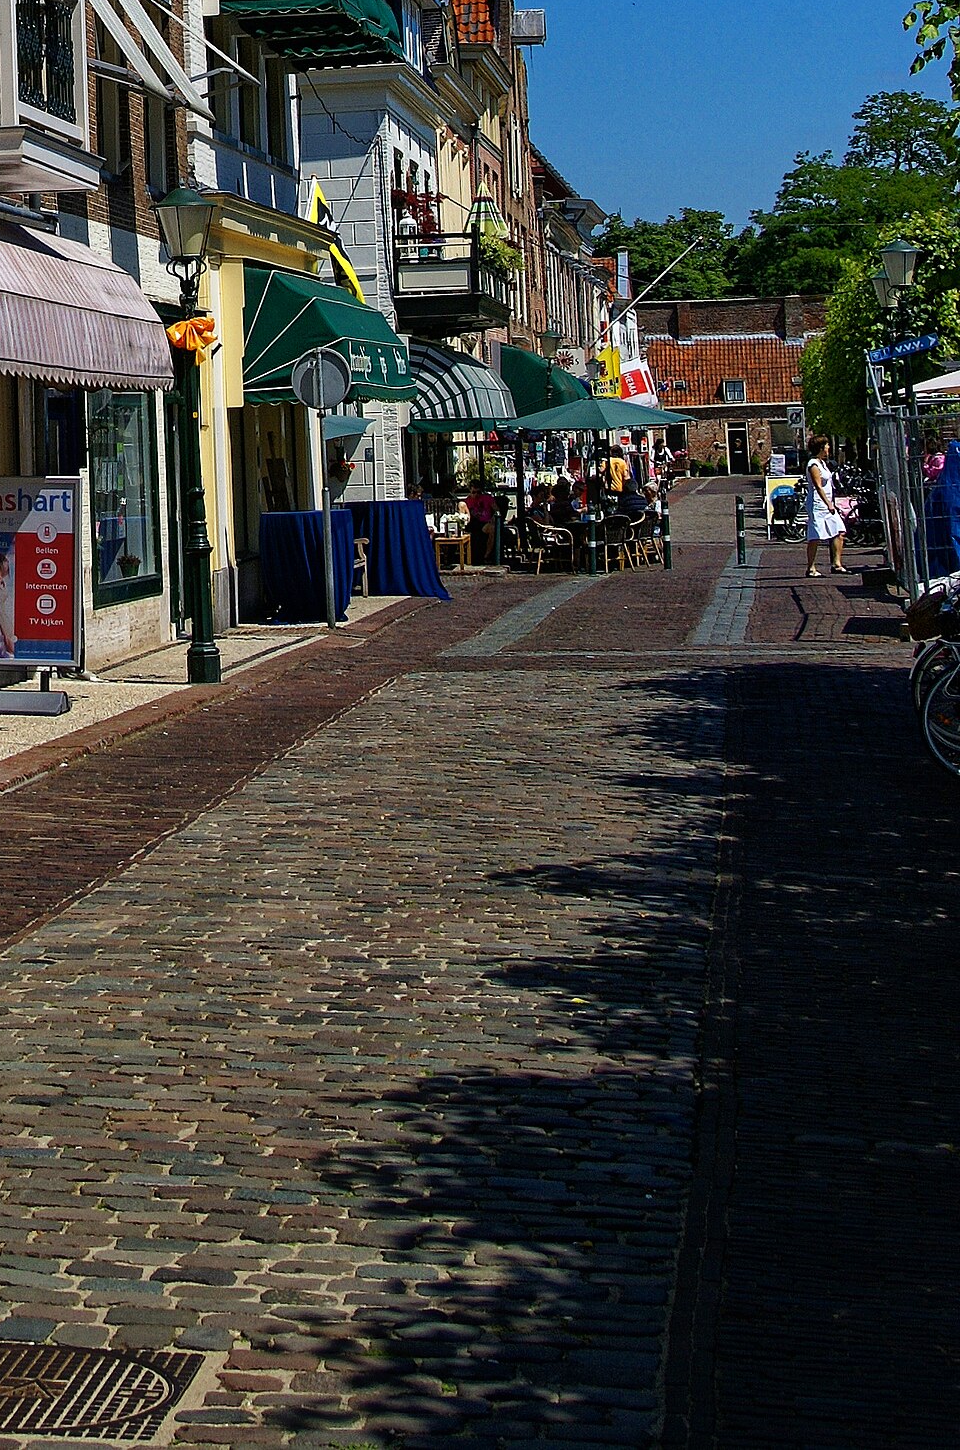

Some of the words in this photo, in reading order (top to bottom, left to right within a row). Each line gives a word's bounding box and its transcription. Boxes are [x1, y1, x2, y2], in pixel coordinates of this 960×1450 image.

[623, 372, 638, 396] HEMA
[35, 546, 59, 555] Bellen
[25, 582, 68, 591] Internetten
[29, 617, 39, 626] TV
[40, 617, 64, 627] kijken
